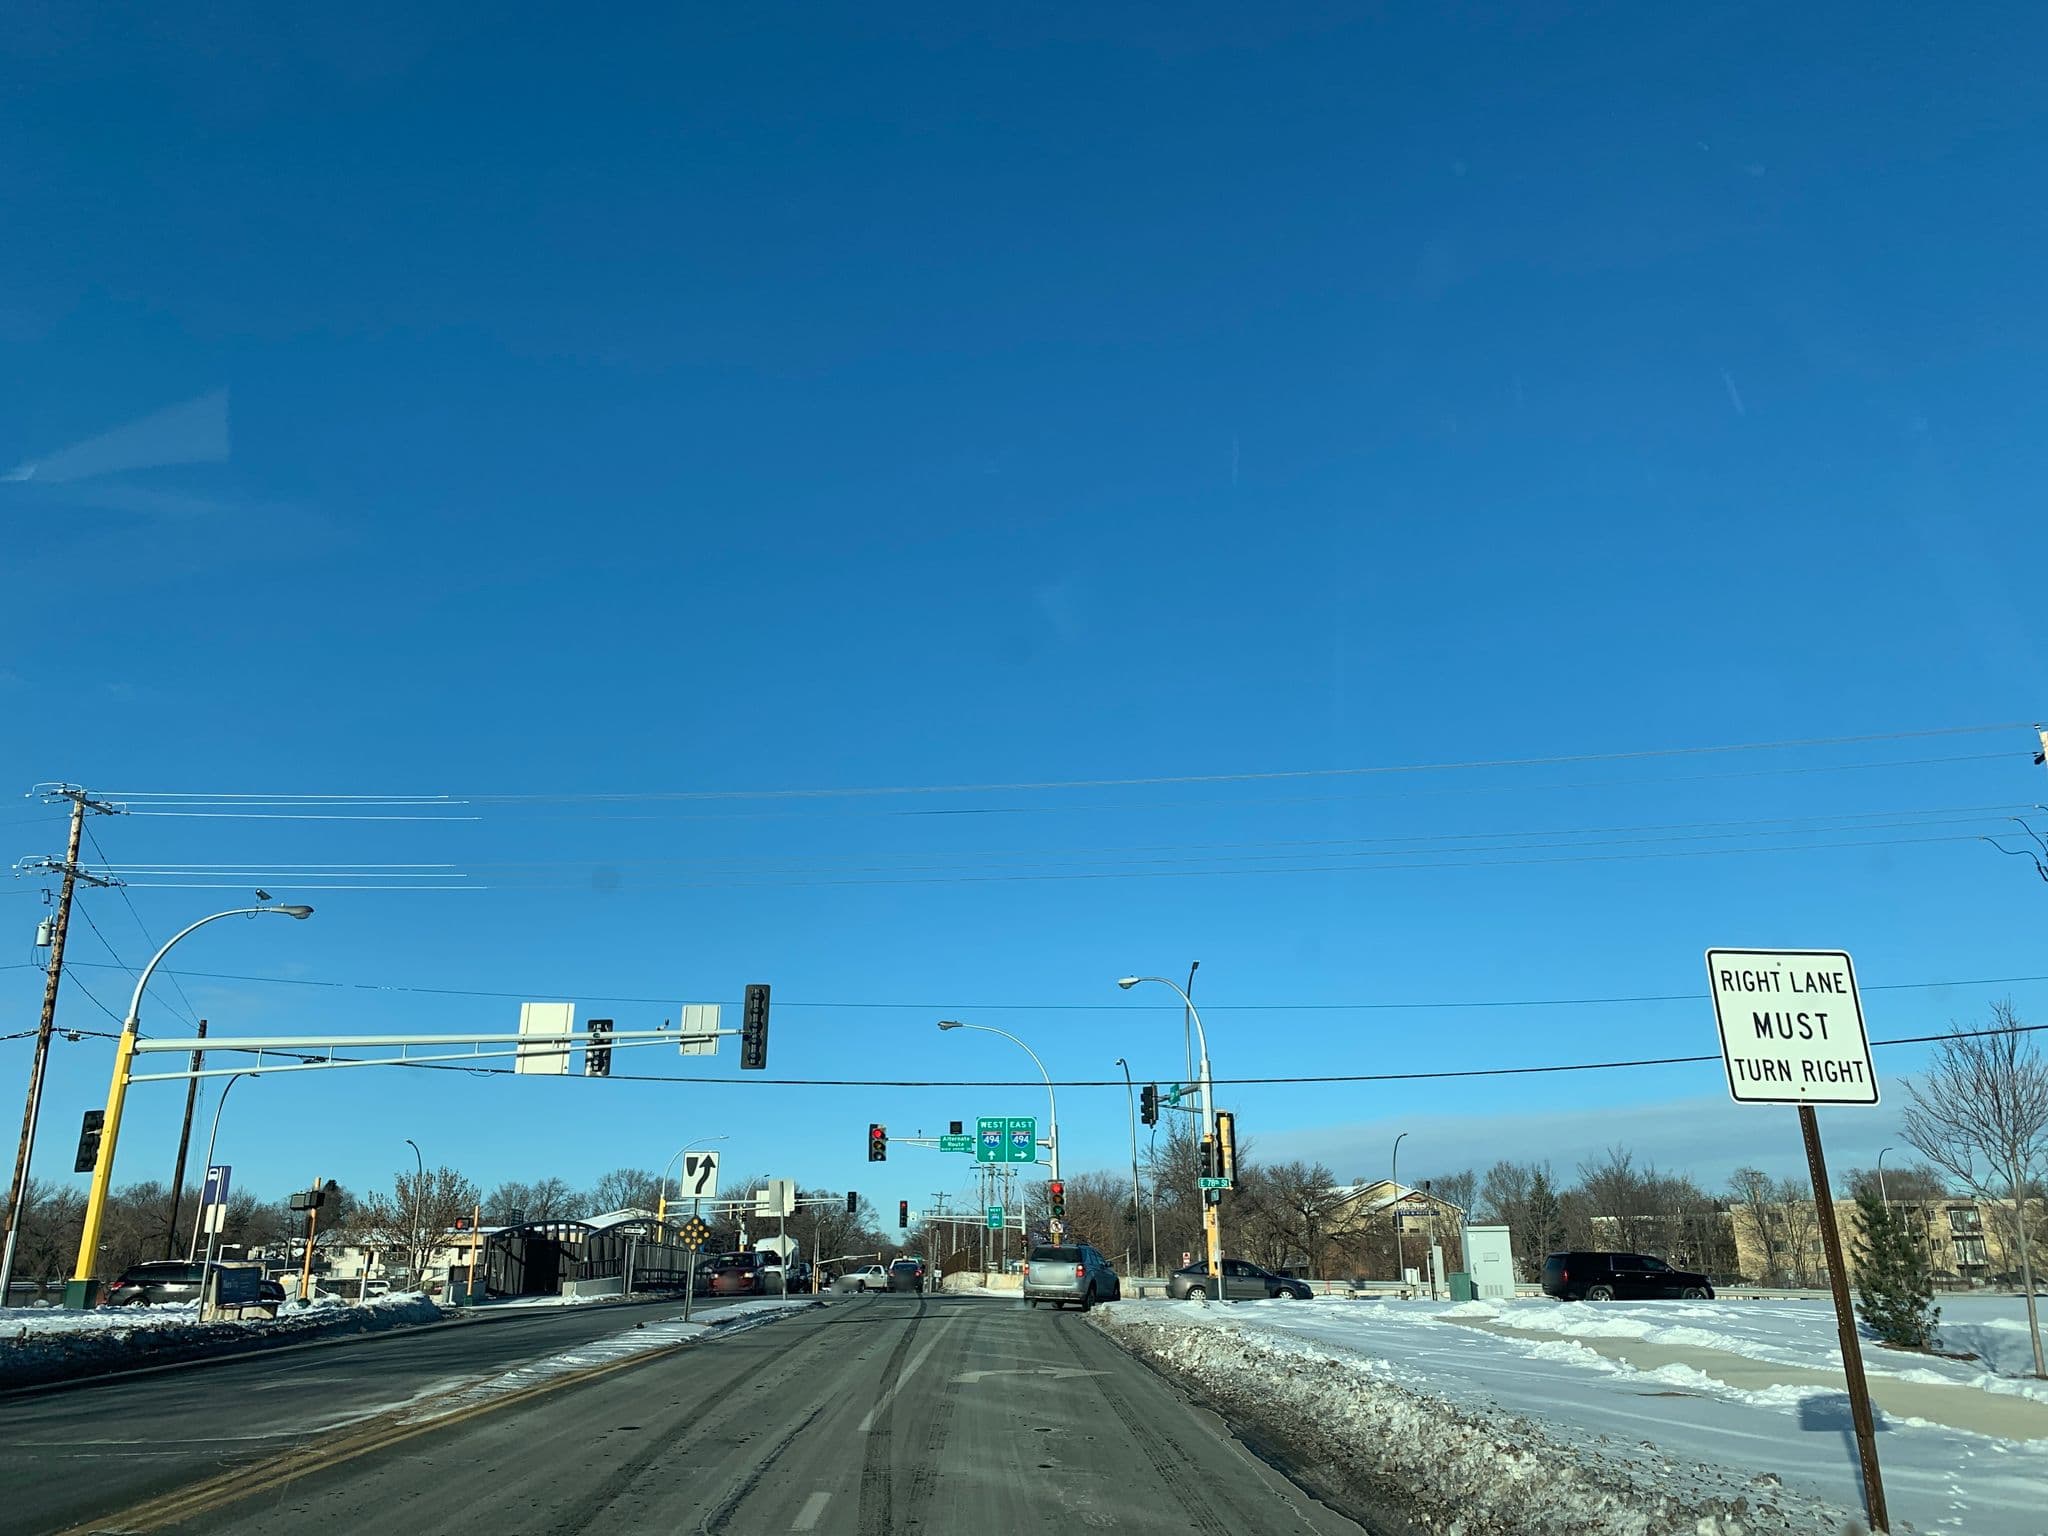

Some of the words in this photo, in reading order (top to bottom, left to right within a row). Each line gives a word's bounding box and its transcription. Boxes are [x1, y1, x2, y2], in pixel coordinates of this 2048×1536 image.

[1720, 970, 1781, 993] RIGHT
[1789, 971, 1847, 994] LANE
[1752, 1011, 1828, 1040] MUST
[1734, 1058, 1793, 1082] TURN
[1801, 1060, 1863, 1083] RIGHT
[983, 1135, 1000, 1144] 494
[1013, 1135, 1029, 1144] 494
